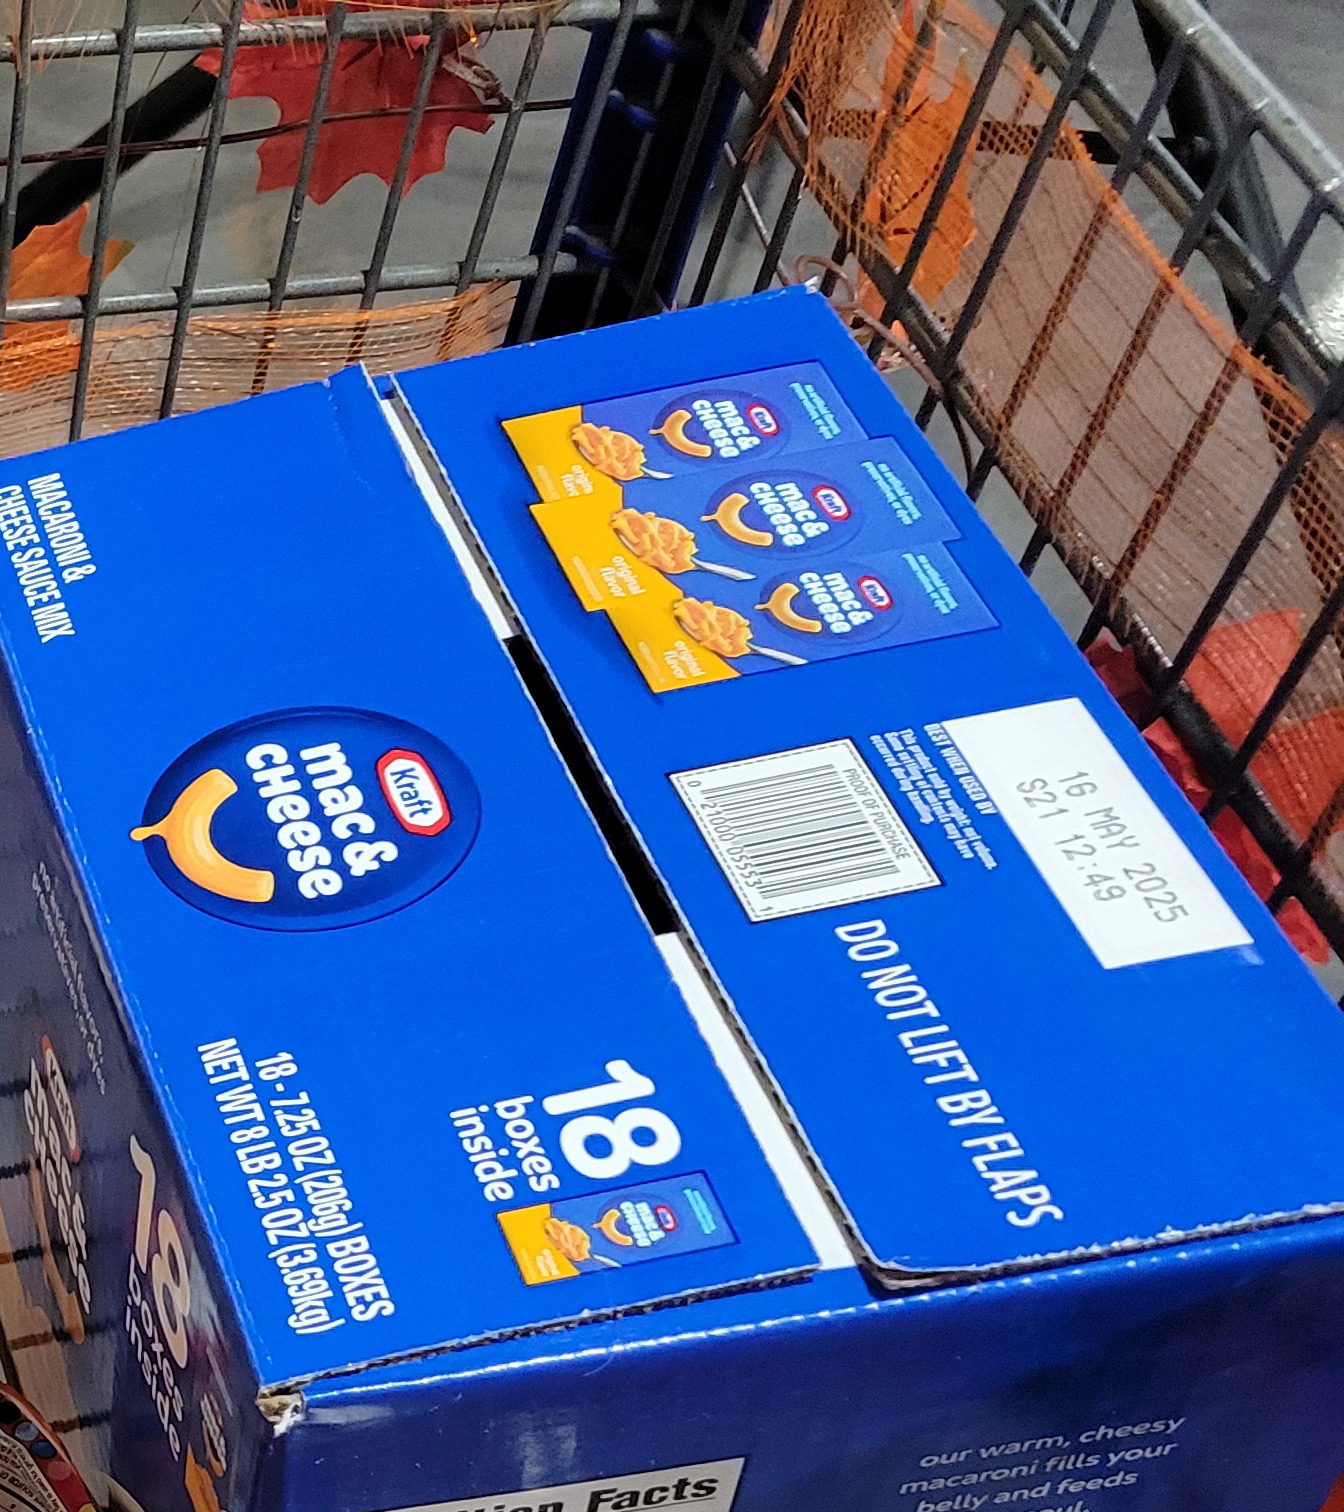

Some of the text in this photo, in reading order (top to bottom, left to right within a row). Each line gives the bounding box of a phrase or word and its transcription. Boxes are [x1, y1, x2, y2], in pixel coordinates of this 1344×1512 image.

[27, 472, 97, 584] MACARONI &
[10, 545, 57, 607] SAUCE
[34, 600, 75, 643] MIX
[299, 742, 399, 877] mac &
[388, 766, 434, 822] Kraft
[842, 768, 911, 860] PROOF OF PURCHASE
[1015, 778, 1127, 905] S21 12:49
[1058, 770, 1189, 925] 16 MAY 2025
[834, 920, 899, 962] DO
[863, 961, 938, 1019] NOT
[898, 1009, 978, 1088] LIFT
[449, 1104, 515, 1203] inside
[494, 1095, 560, 1193] boxes
[542, 1059, 682, 1180] 18
[935, 1087, 1004, 1126] BY
[197, 1037, 346, 1335] NET WT 8 LB 2.5 OZ (3.69kg)
[254, 1051, 396, 1322] 18 7.25 OZ (206g) BOXES
[961, 1123, 1064, 1229] FLAPS
[125, 1304, 180, 1462] inside
[129, 1252, 184, 1422] boxes
[899, 1442, 1178, 1494] macaroni fills your
[919, 1415, 1186, 1469] our warm, cheesy
[585, 1476, 720, 1512] Facts
[994, 1482, 1051, 1505] and
